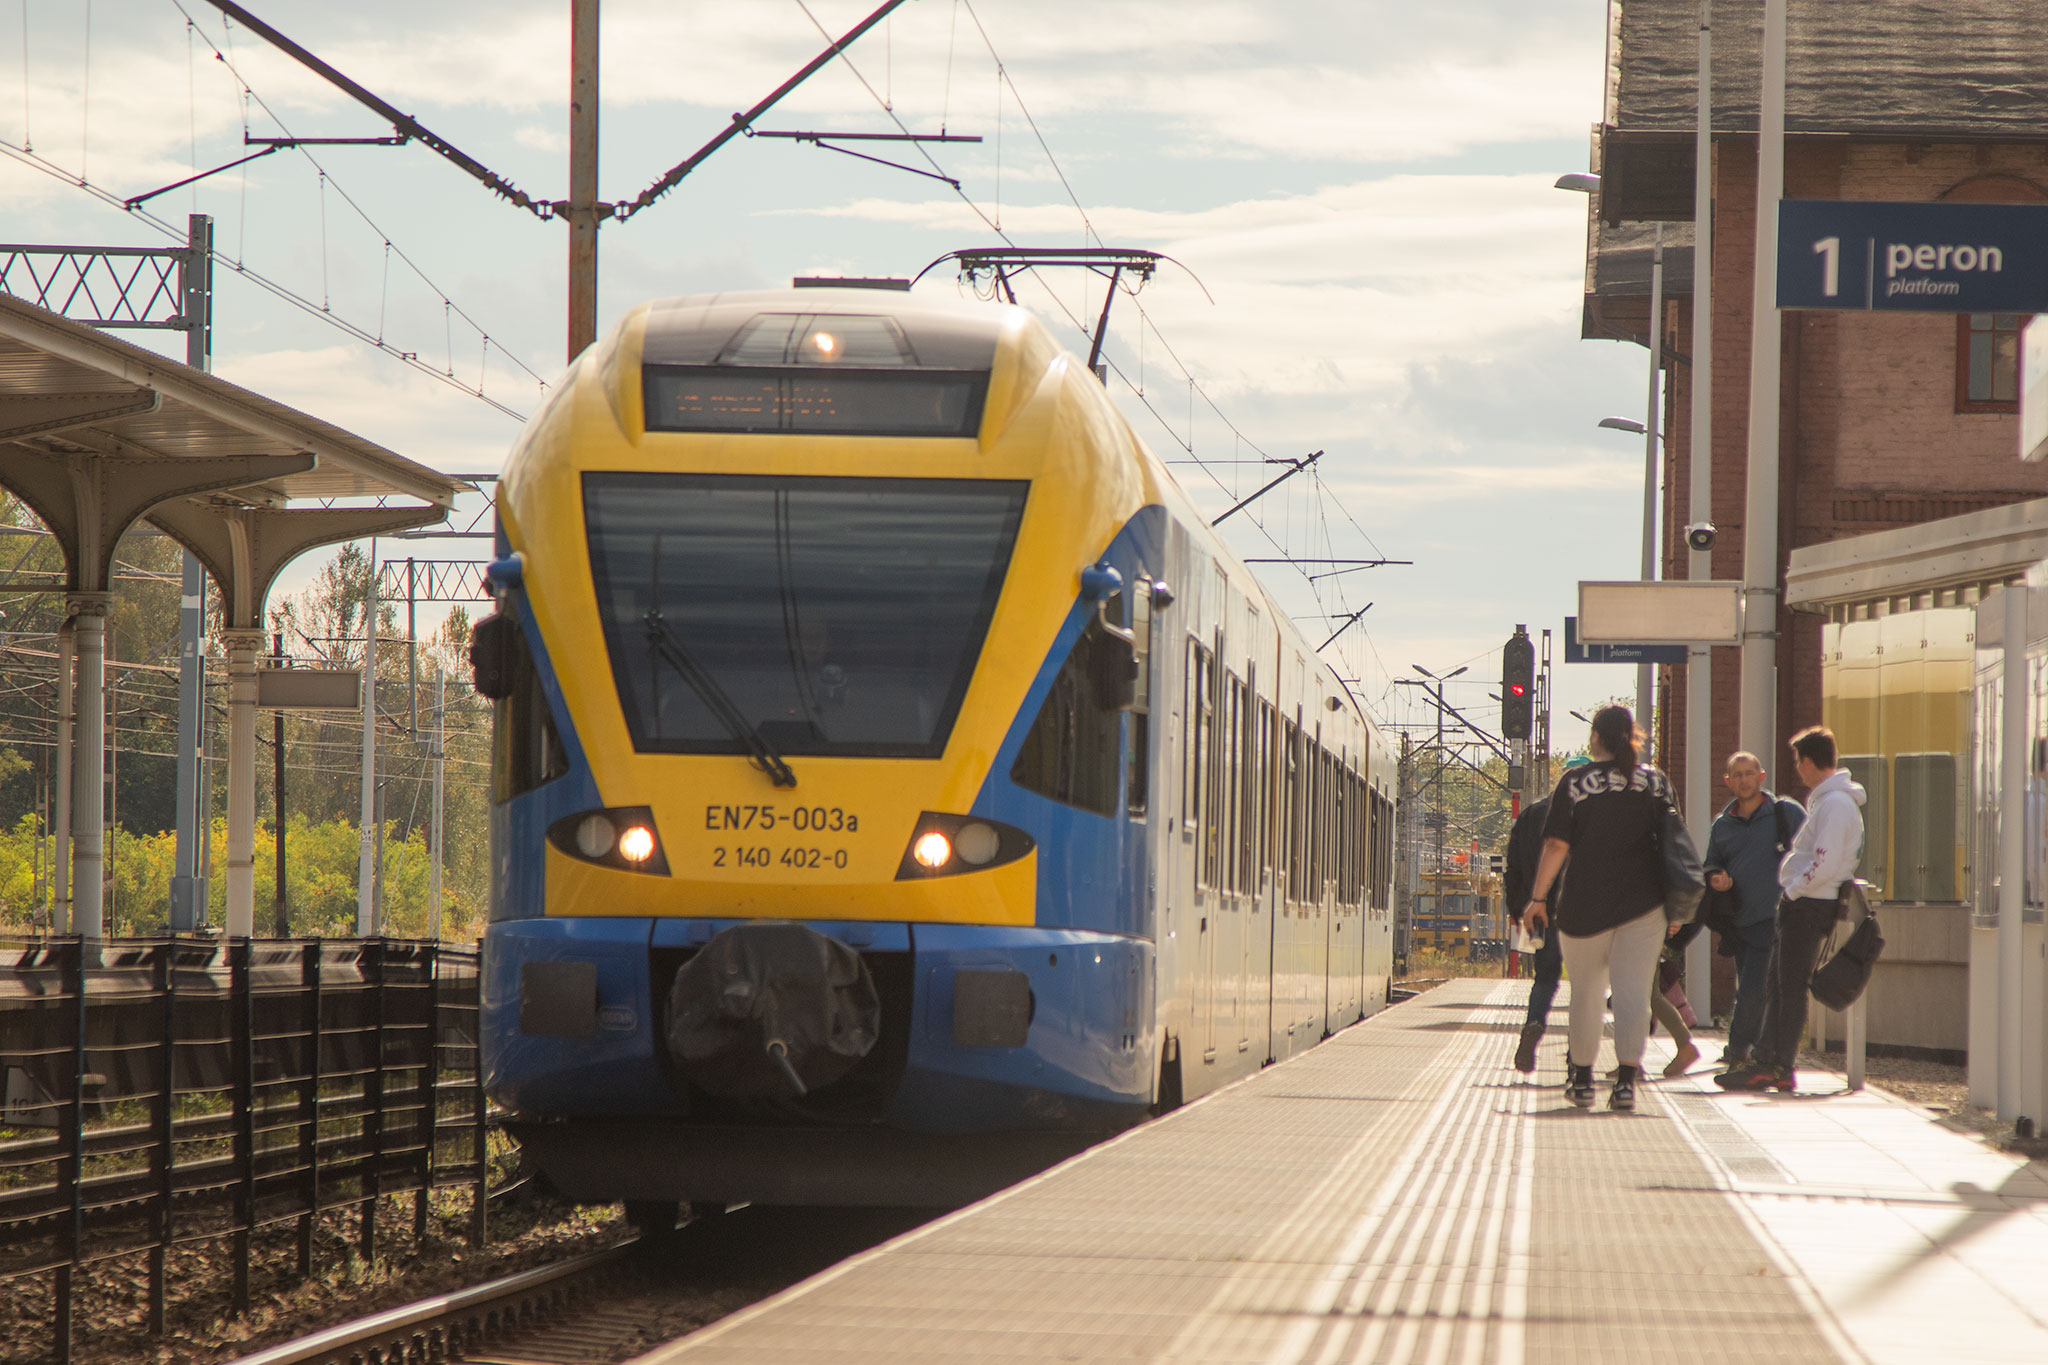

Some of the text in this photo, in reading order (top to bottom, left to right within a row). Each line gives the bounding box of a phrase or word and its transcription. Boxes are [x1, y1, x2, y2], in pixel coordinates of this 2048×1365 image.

[1813, 236, 2003, 297] 1 peron
[1887, 278, 1960, 297] platform
[1610, 649, 1642, 658] platform
[705, 806, 858, 832] EN75-003a
[713, 847, 848, 869] 2 140 402-0
